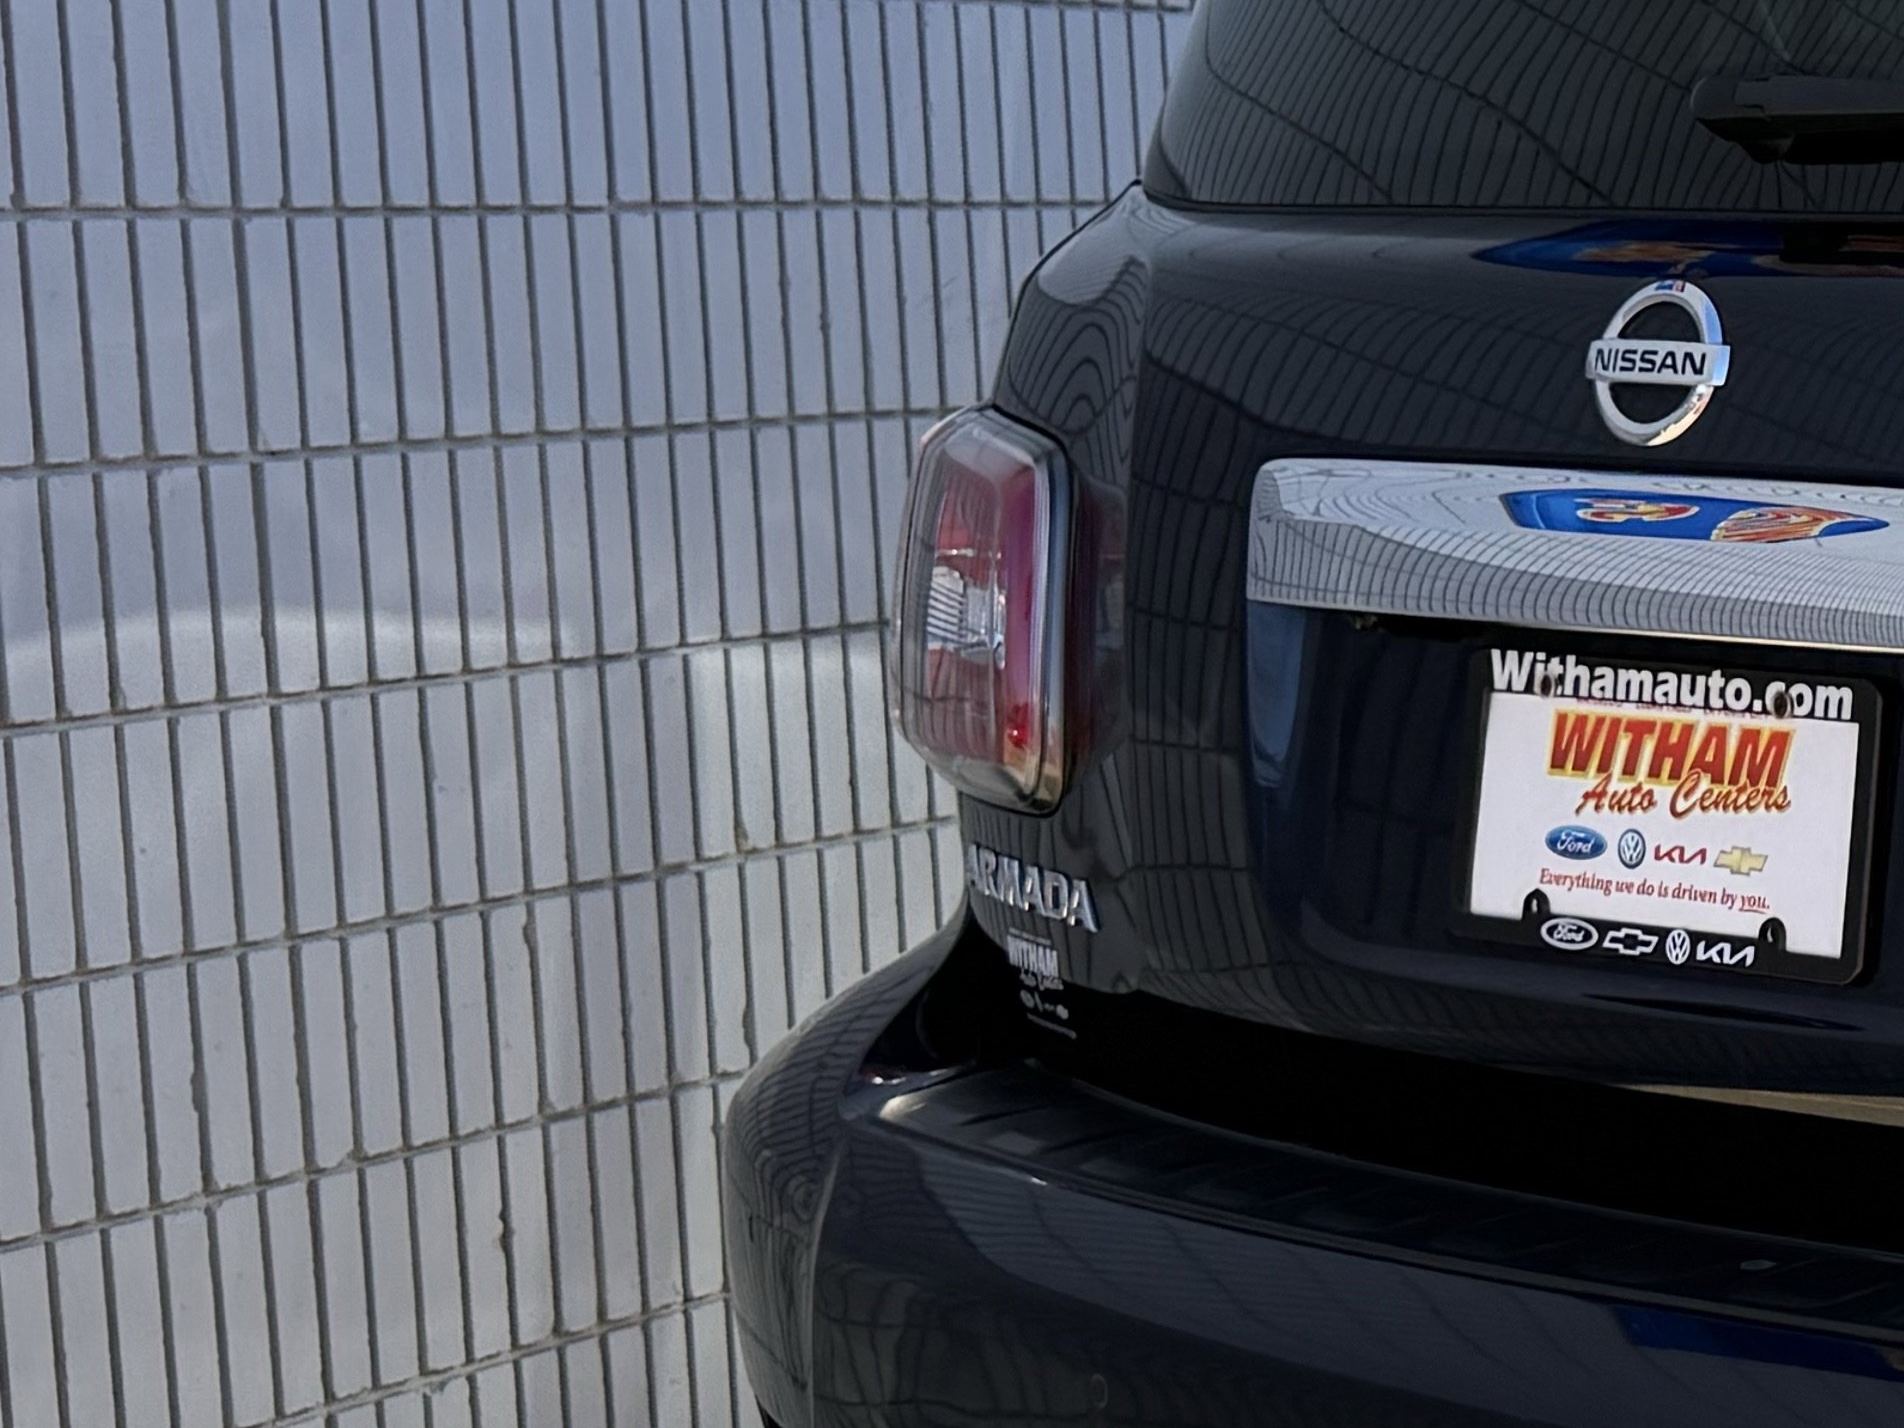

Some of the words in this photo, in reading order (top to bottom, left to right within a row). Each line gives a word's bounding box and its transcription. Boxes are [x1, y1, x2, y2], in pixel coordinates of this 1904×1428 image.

[1594, 347, 1707, 376] NISSAN
[1490, 649, 1854, 721] Withamauto.com
[1548, 708, 1796, 788] WITHAM
[1574, 772, 1658, 816] Auto
[1669, 767, 1793, 820] Centers
[968, 843, 1101, 934] ARMADA
[1539, 867, 1612, 898] Everything
[1615, 880, 1634, 893] we
[1636, 878, 1656, 898] do
[1657, 882, 1669, 899] is
[1671, 882, 1718, 905] driven
[1720, 887, 1739, 910] by
[1739, 894, 1771, 912] you.
